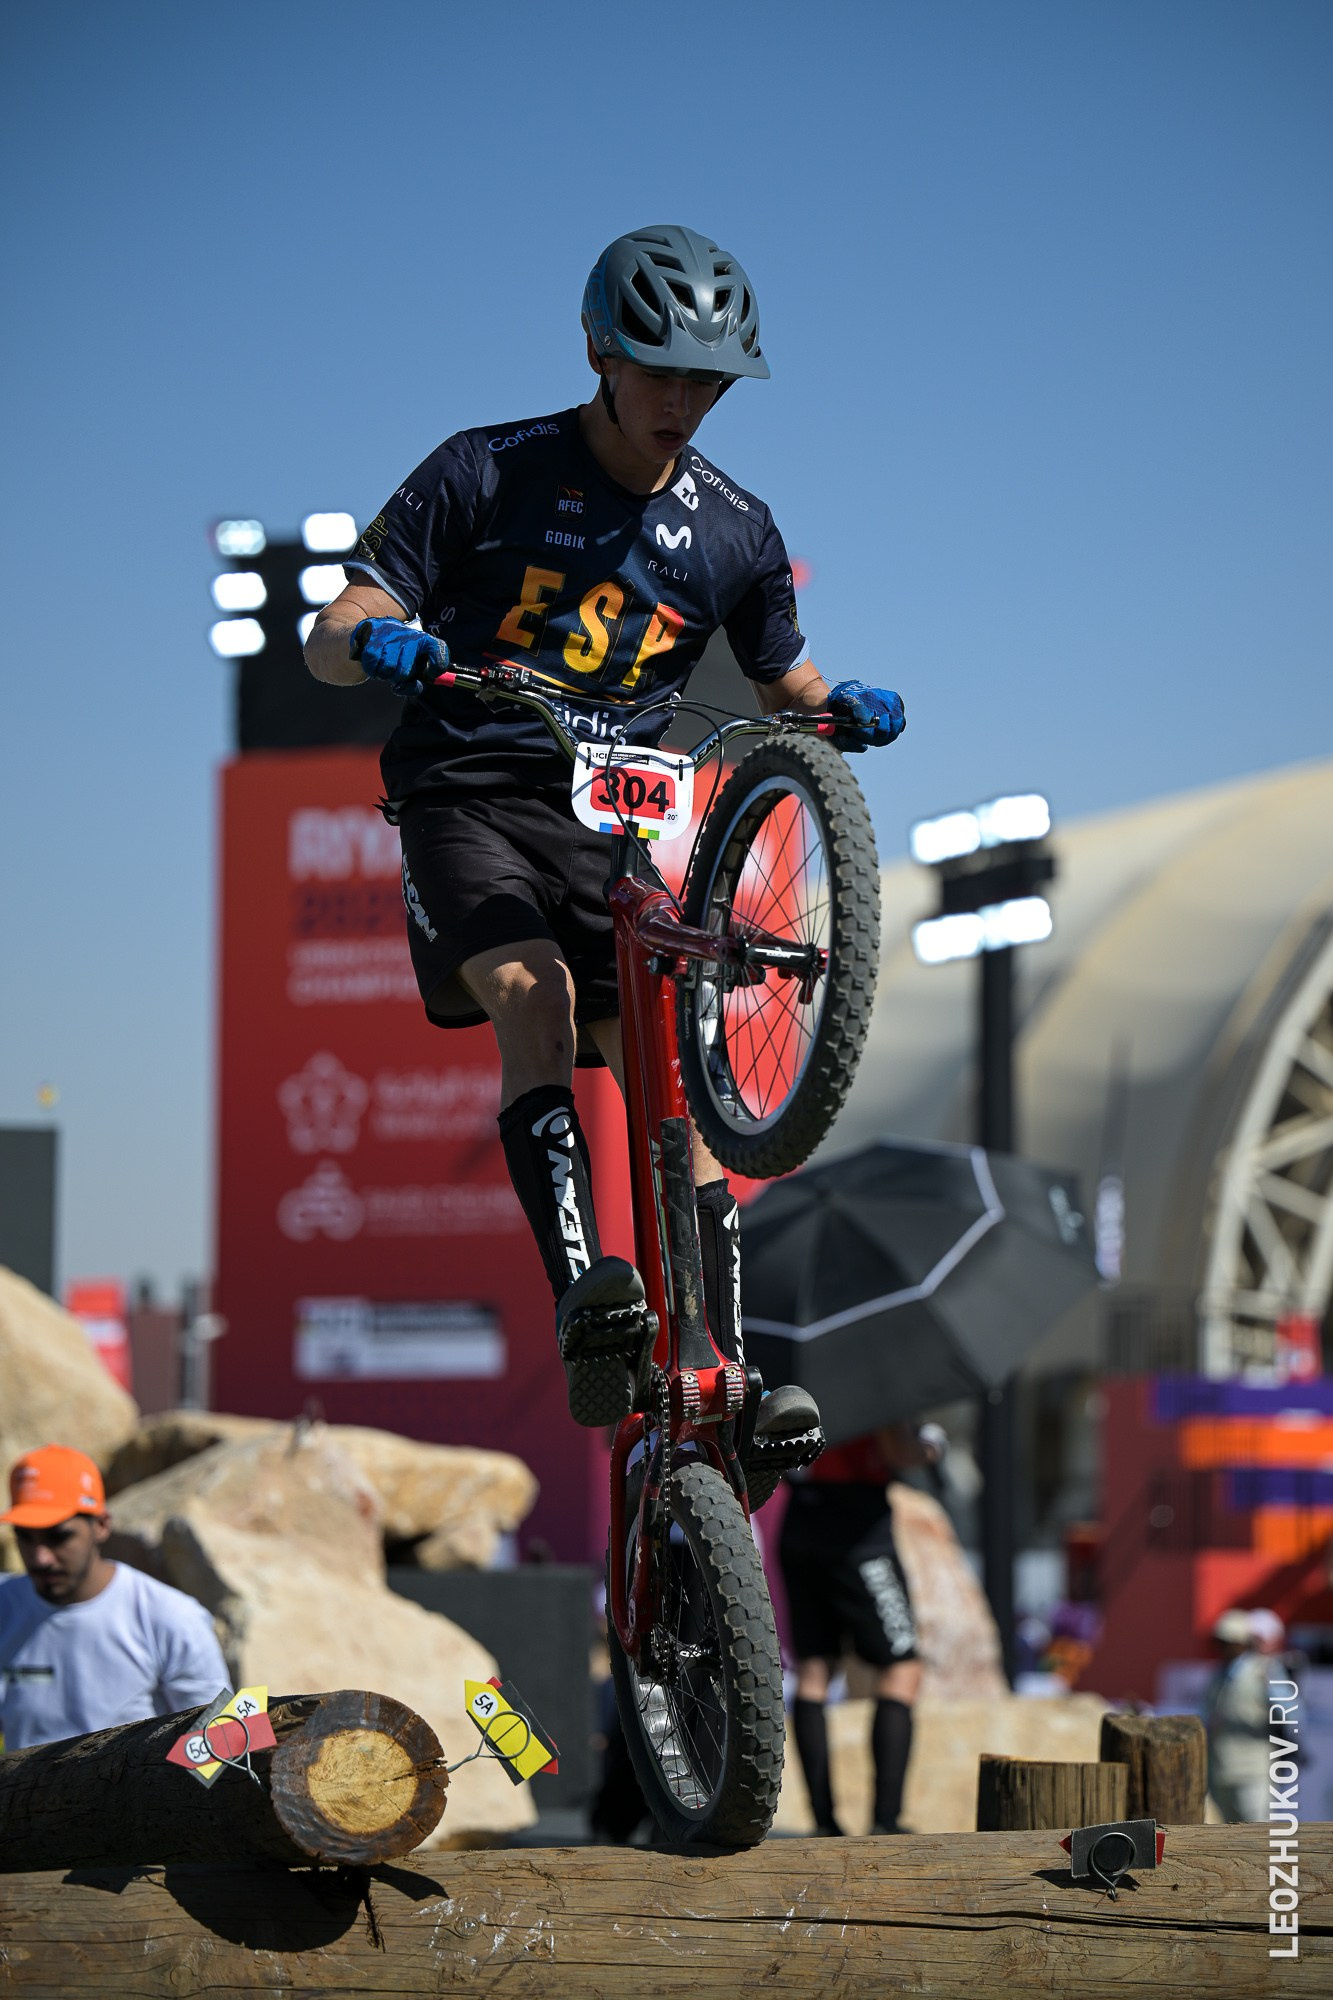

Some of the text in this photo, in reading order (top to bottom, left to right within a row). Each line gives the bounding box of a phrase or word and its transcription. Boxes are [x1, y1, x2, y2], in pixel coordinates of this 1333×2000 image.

[488, 423, 559, 451] Cofidis
[691, 456, 749, 512] Cofidis
[396, 487, 423, 510] ALI
[558, 499, 583, 514] RFEC
[545, 530, 585, 549] GOBIK
[648, 560, 689, 582] RALI
[496, 565, 686, 690] ESP
[598, 773, 669, 812] 304
[236, 1700, 256, 1718] 5A
[475, 1694, 494, 1715] 5A
